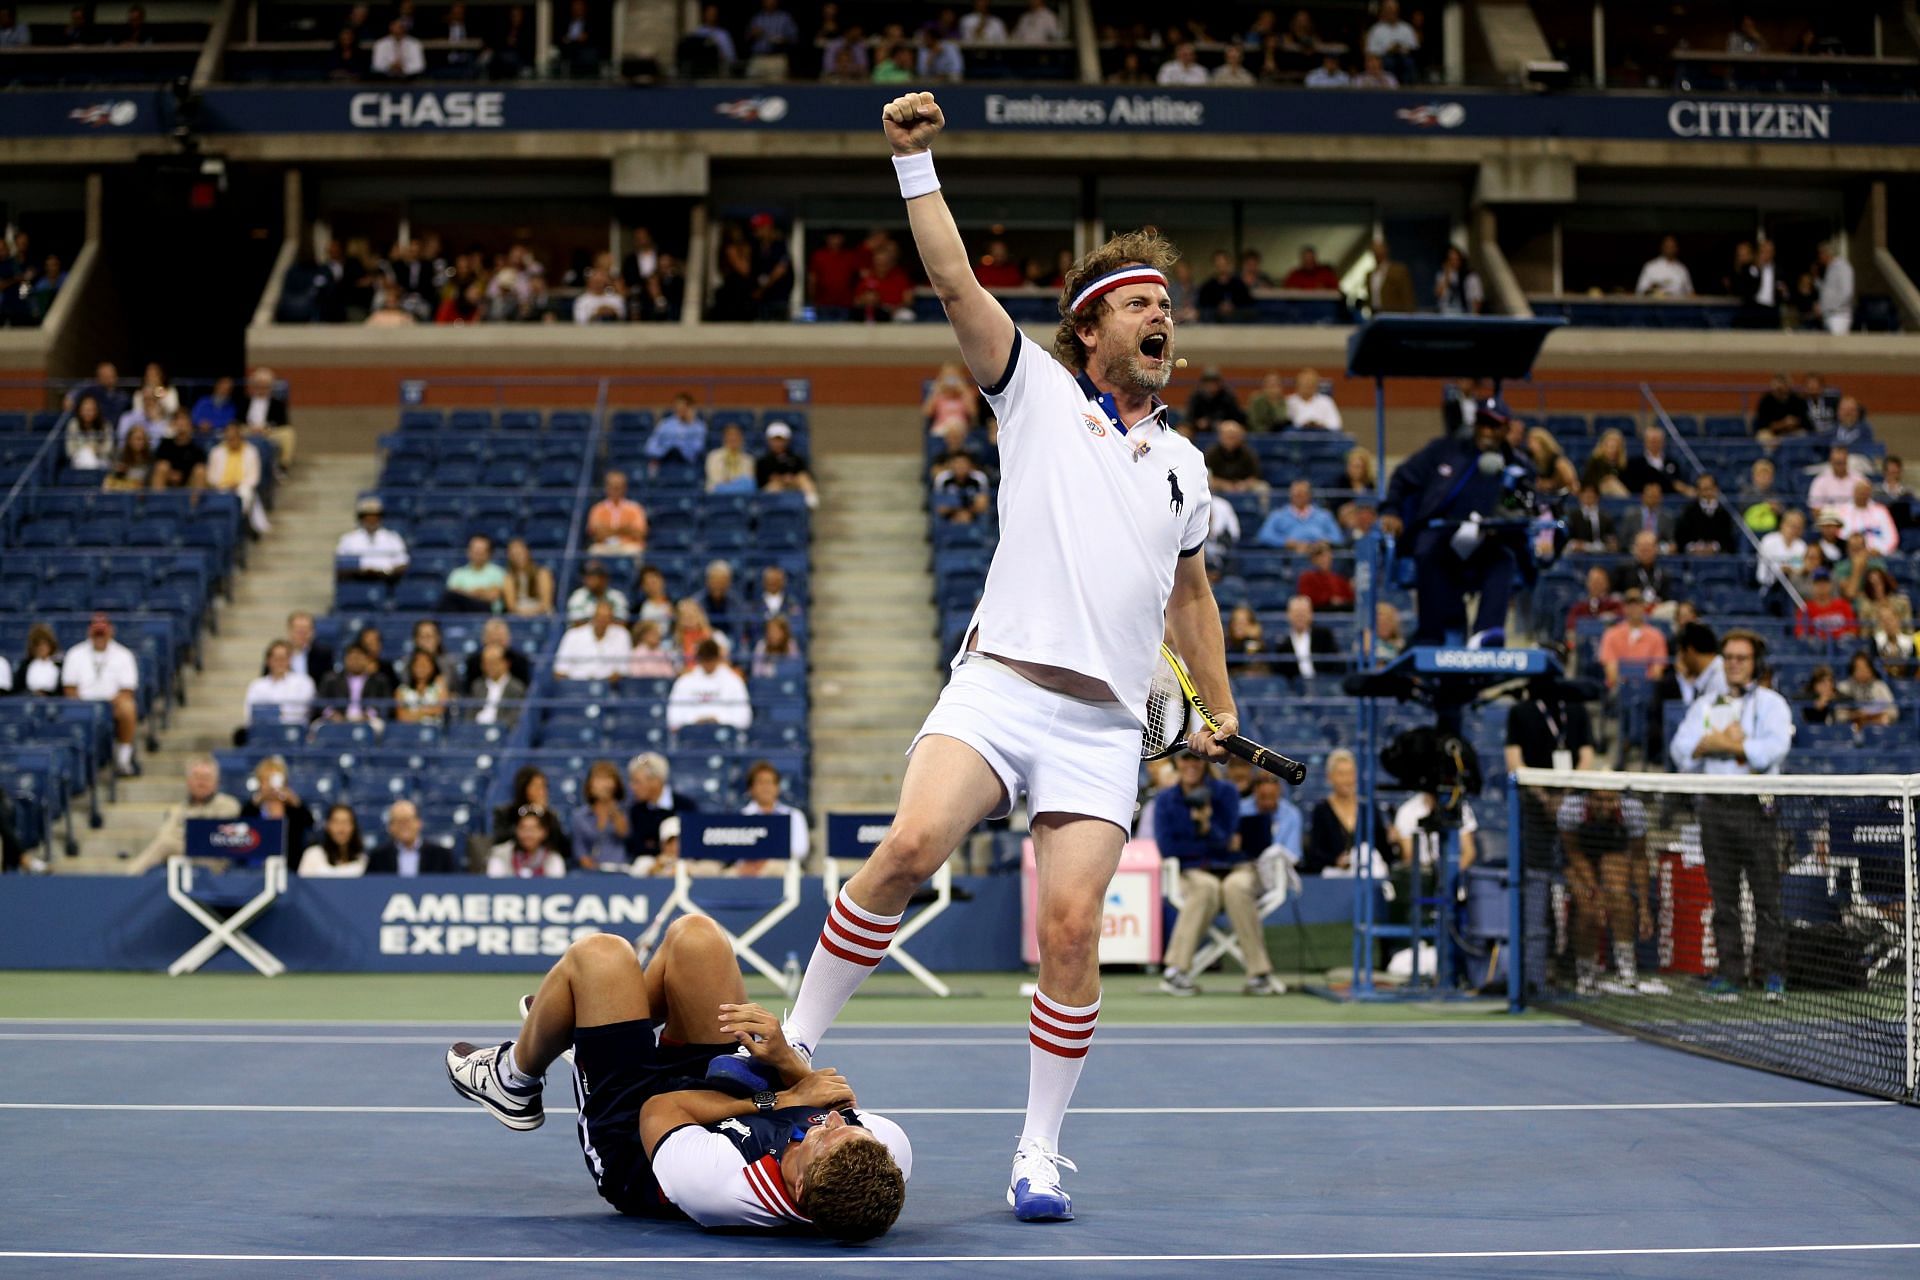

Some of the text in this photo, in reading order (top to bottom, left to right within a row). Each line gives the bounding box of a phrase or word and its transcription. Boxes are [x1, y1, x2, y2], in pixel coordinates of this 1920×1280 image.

[351, 92, 503, 127] CHASE
[985, 95, 1204, 125] Emirates Airline
[1668, 100, 1830, 139] CITIZEN
[1435, 650, 1528, 671] usopen.org
[381, 894, 649, 923] AMERICAN
